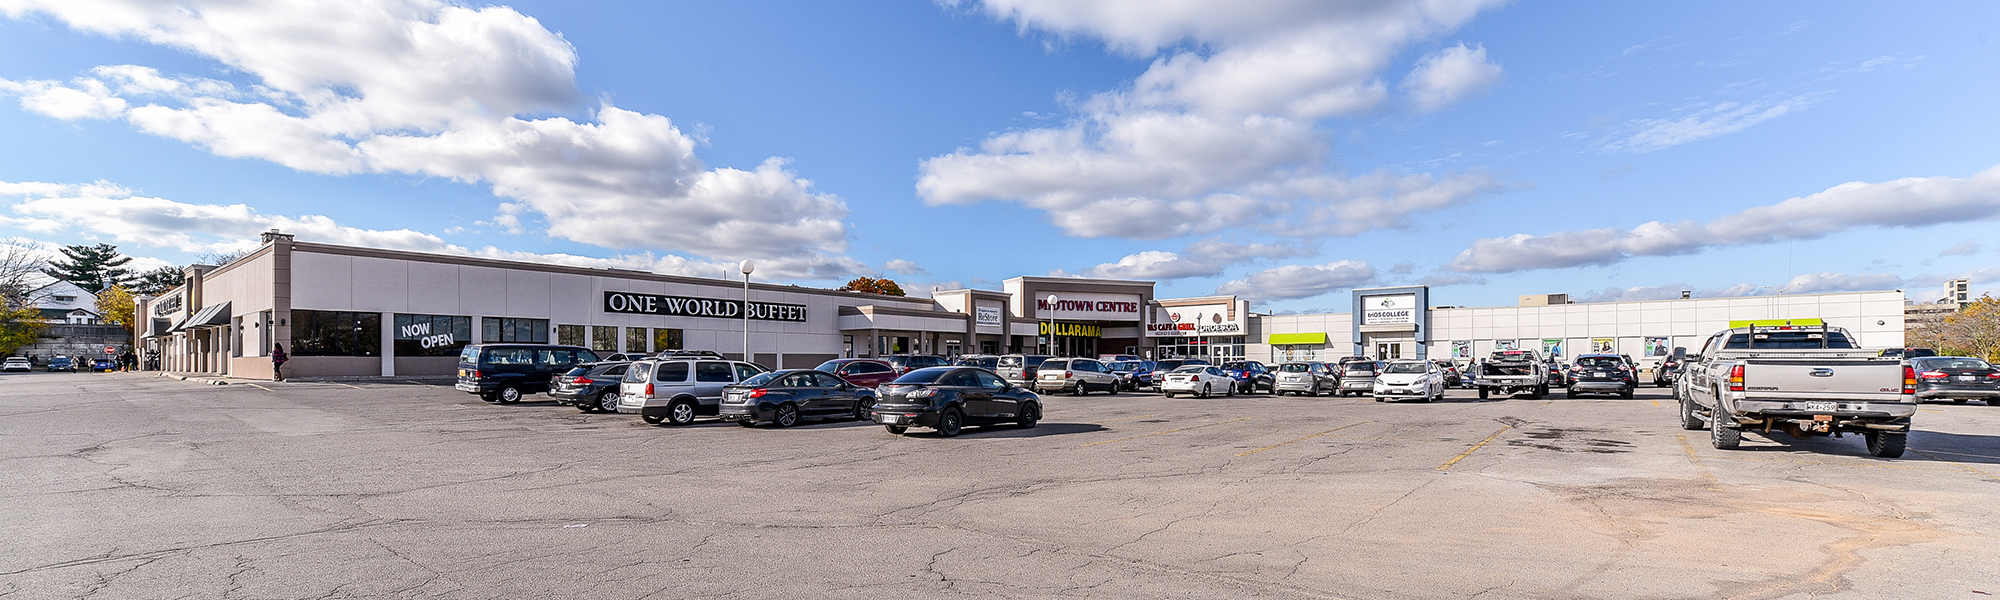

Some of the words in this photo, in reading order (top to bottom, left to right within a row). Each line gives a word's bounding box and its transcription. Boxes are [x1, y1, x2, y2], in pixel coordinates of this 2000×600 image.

[609, 294, 657, 313] ONE
[664, 297, 739, 317] WORLD
[747, 303, 807, 321] BUFFET
[1037, 299, 1094, 312] MDTOWN
[1096, 301, 1138, 313] CENTRE
[401, 322, 430, 338] NOW
[1040, 321, 1102, 338] DOLLARAMA
[1177, 322, 1196, 331] GRILL
[421, 332, 454, 349] OPEN
